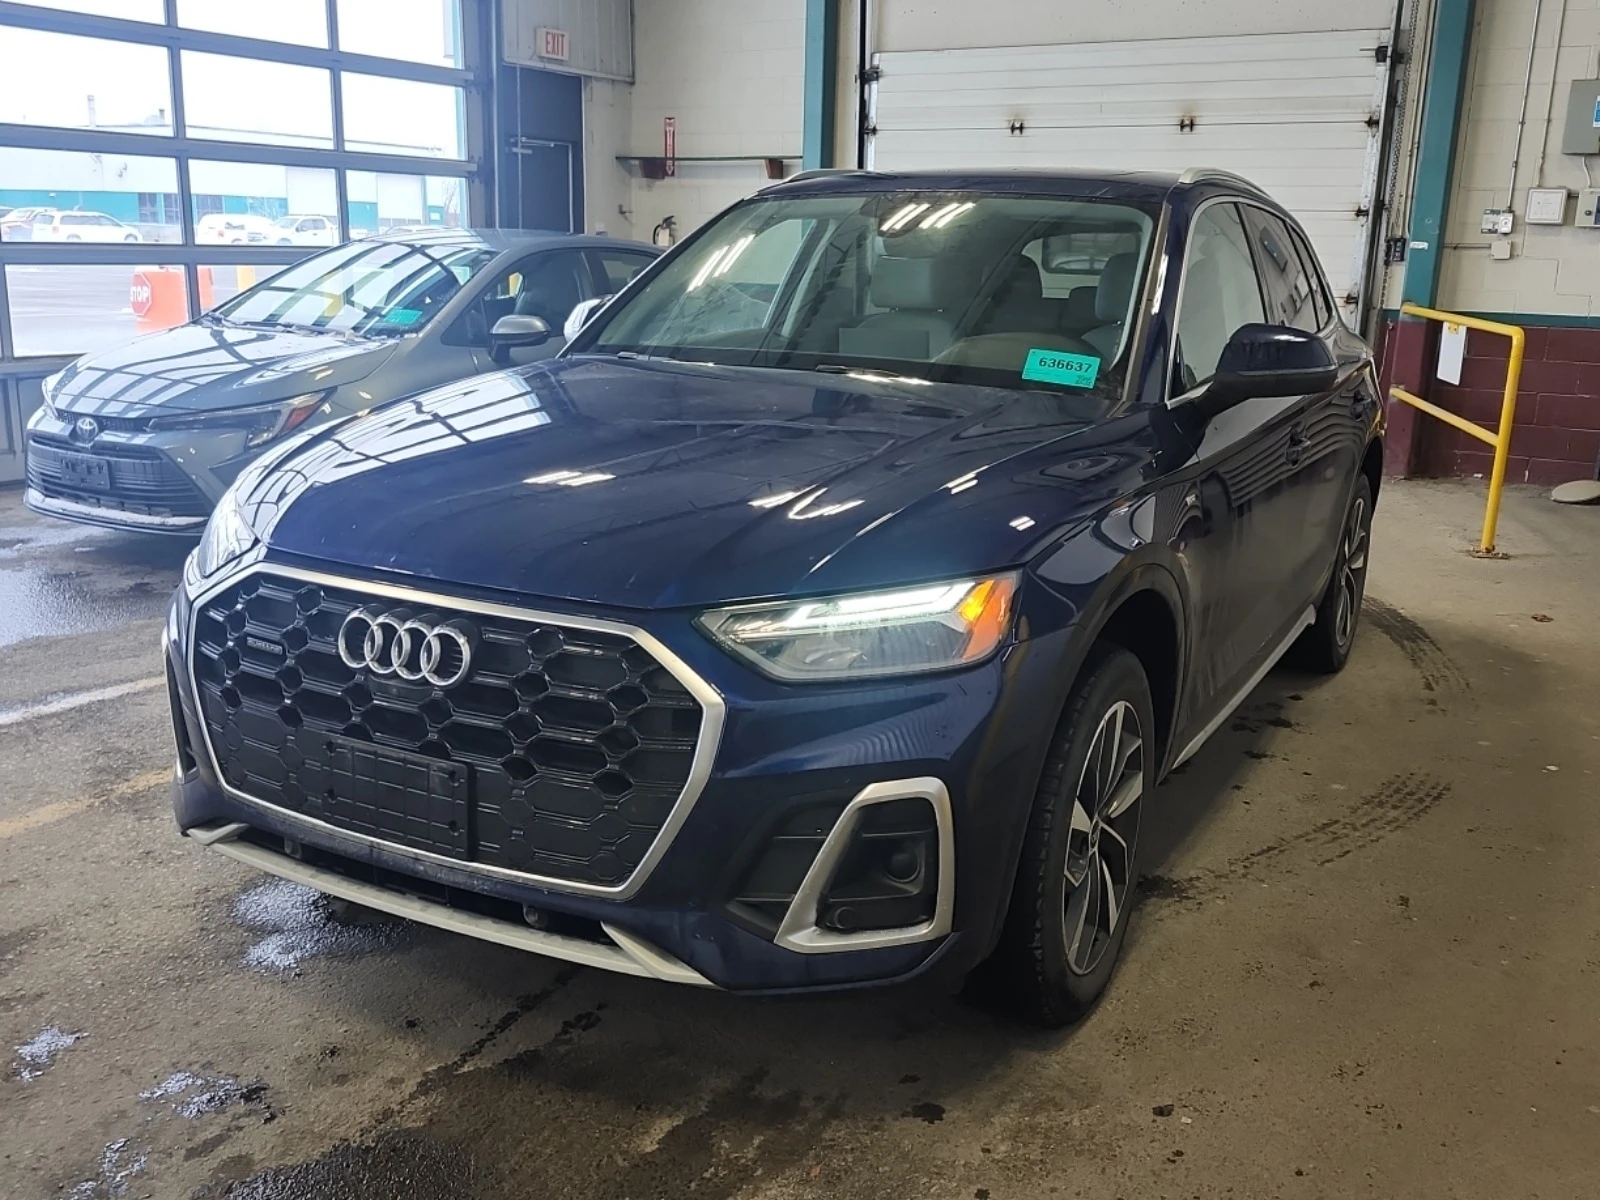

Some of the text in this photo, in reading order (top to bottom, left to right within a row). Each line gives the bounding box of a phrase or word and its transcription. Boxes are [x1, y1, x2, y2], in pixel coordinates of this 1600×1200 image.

[545, 31, 565, 56] EXIT
[130, 286, 149, 302] STOP
[1038, 357, 1093, 373] 636637
